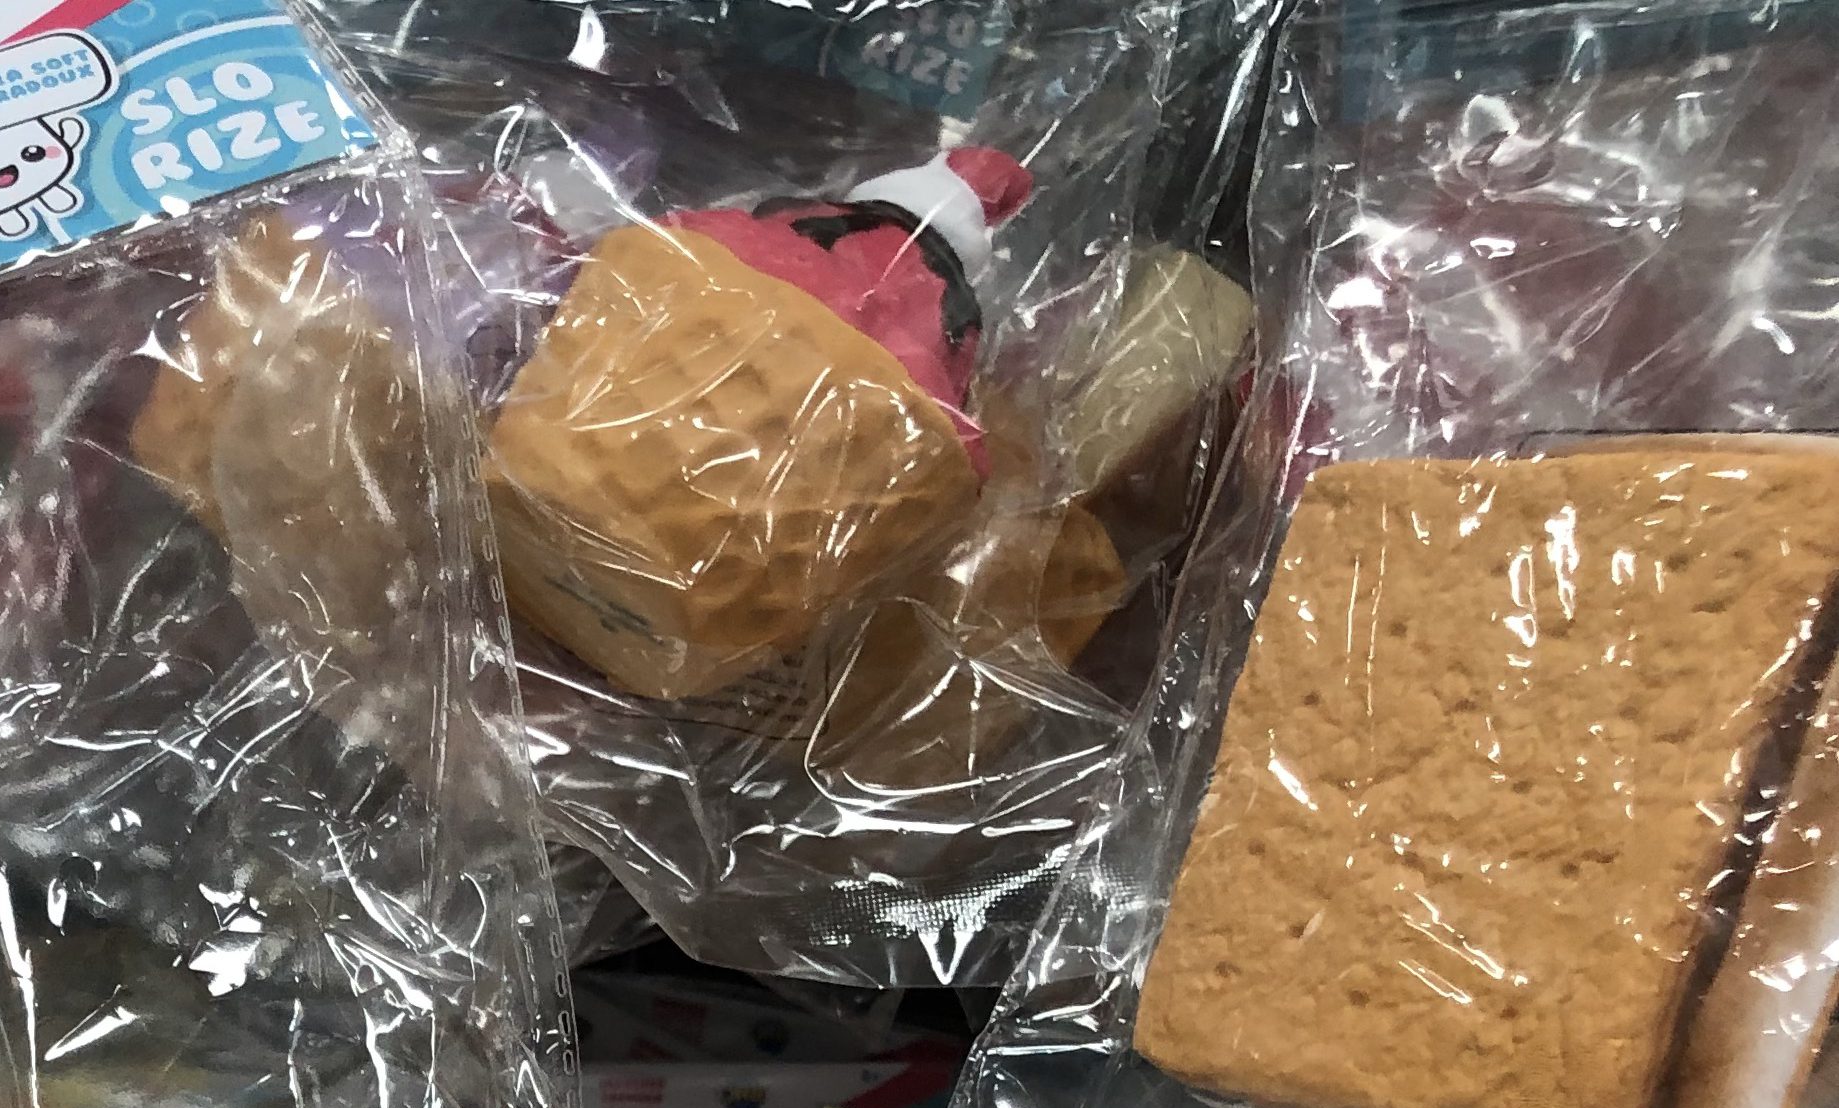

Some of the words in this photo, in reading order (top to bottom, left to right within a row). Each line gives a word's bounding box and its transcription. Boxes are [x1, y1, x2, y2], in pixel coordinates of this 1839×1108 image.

[33, 48, 91, 77] SOFT
[121, 62, 273, 135] SLO
[131, 101, 325, 189] RIZE
